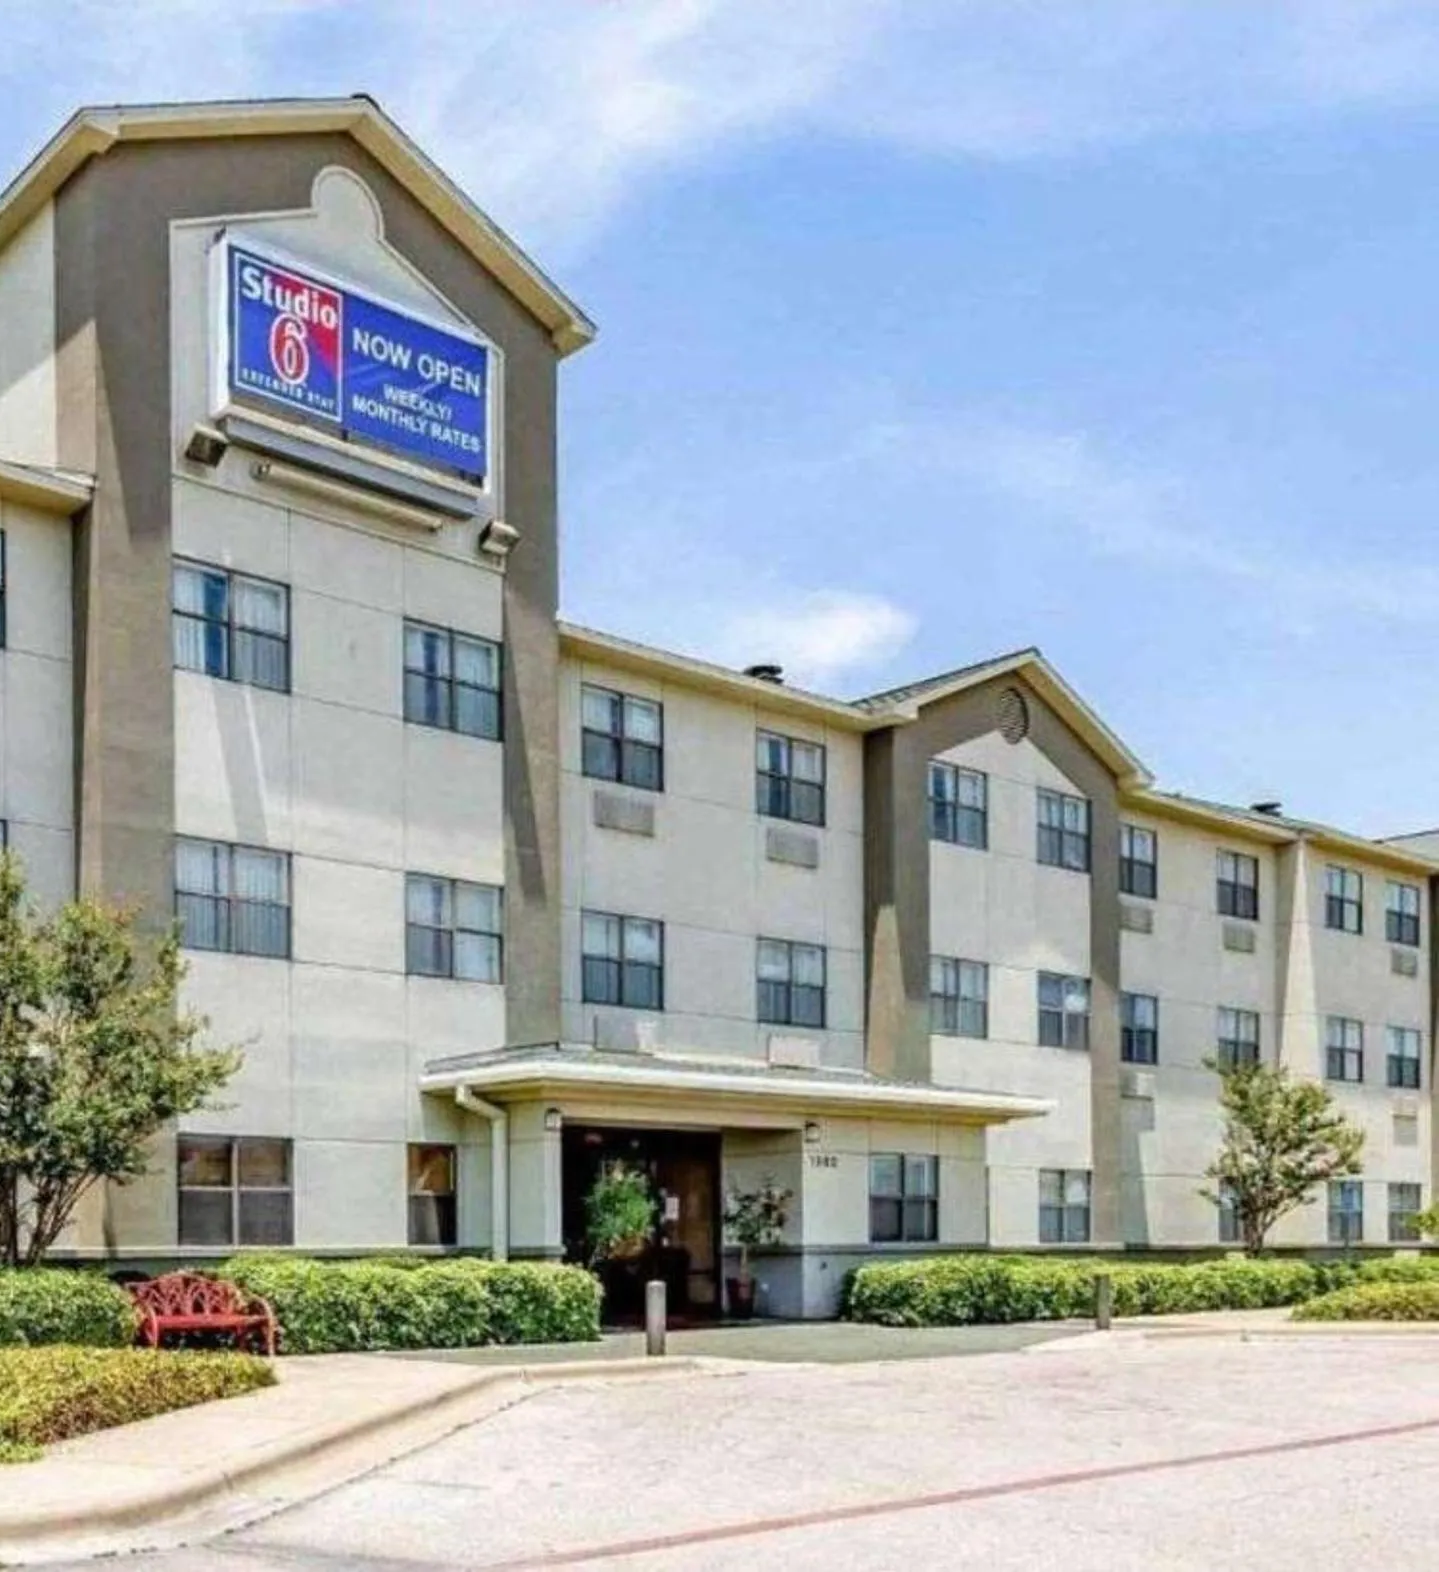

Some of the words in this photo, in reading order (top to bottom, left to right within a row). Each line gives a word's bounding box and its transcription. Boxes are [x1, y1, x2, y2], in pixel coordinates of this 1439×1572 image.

[241, 264, 339, 330] Studio
[270, 311, 310, 385] 6
[352, 327, 412, 370] NOW
[417, 353, 481, 397] OPEN
[352, 394, 428, 434] MONTHLY
[430, 422, 481, 453] RATES
